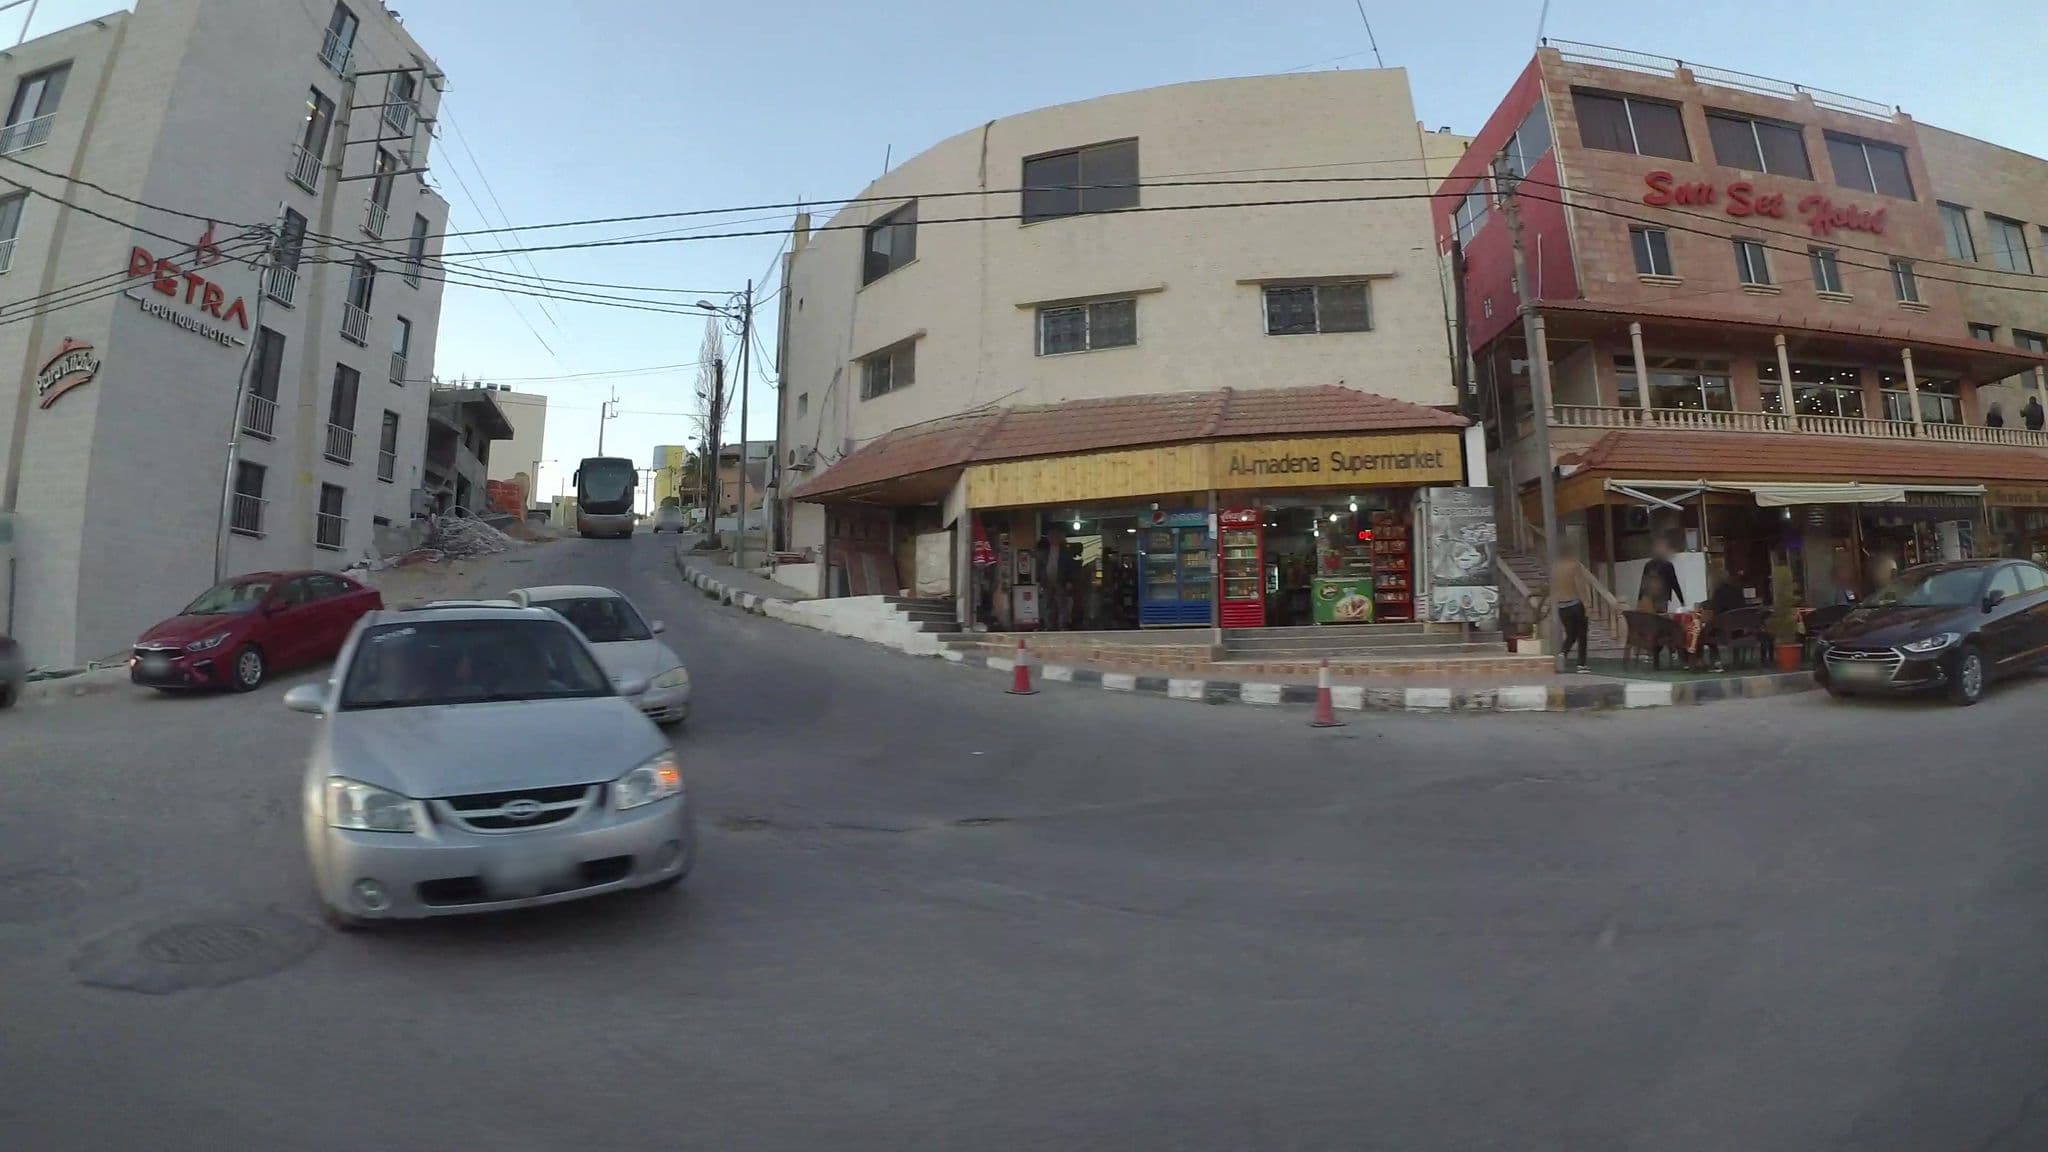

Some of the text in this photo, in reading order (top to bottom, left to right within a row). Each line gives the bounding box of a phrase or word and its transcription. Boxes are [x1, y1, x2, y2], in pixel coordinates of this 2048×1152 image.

[1726, 181, 1785, 218] Set
[127, 246, 249, 330] PETRA
[141, 298, 234, 347] BOUTIQUE HOTEL
[1229, 449, 1444, 476] Al-madena Supermarket
